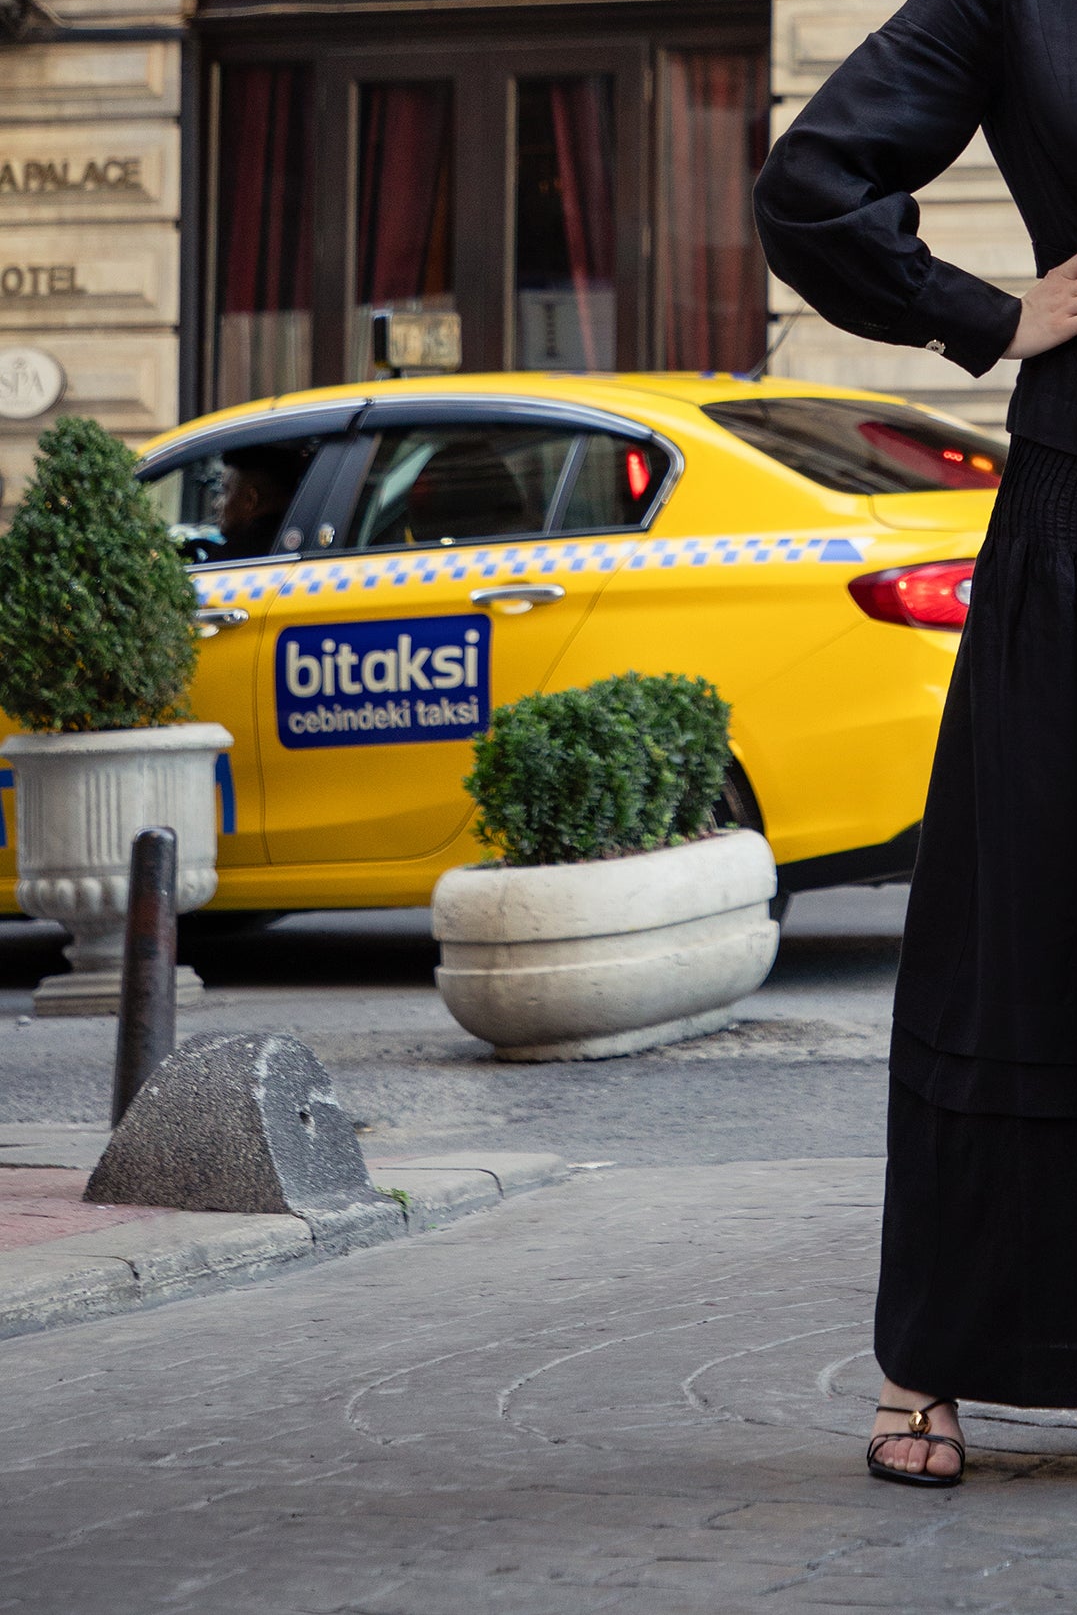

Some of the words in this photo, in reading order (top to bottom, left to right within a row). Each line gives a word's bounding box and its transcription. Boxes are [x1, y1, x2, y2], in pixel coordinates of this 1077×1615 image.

[22, 156, 142, 192] PALACE
[286, 629, 480, 698] bitaksi
[288, 699, 411, 734] cebindeki
[415, 695, 479, 727] taksi
